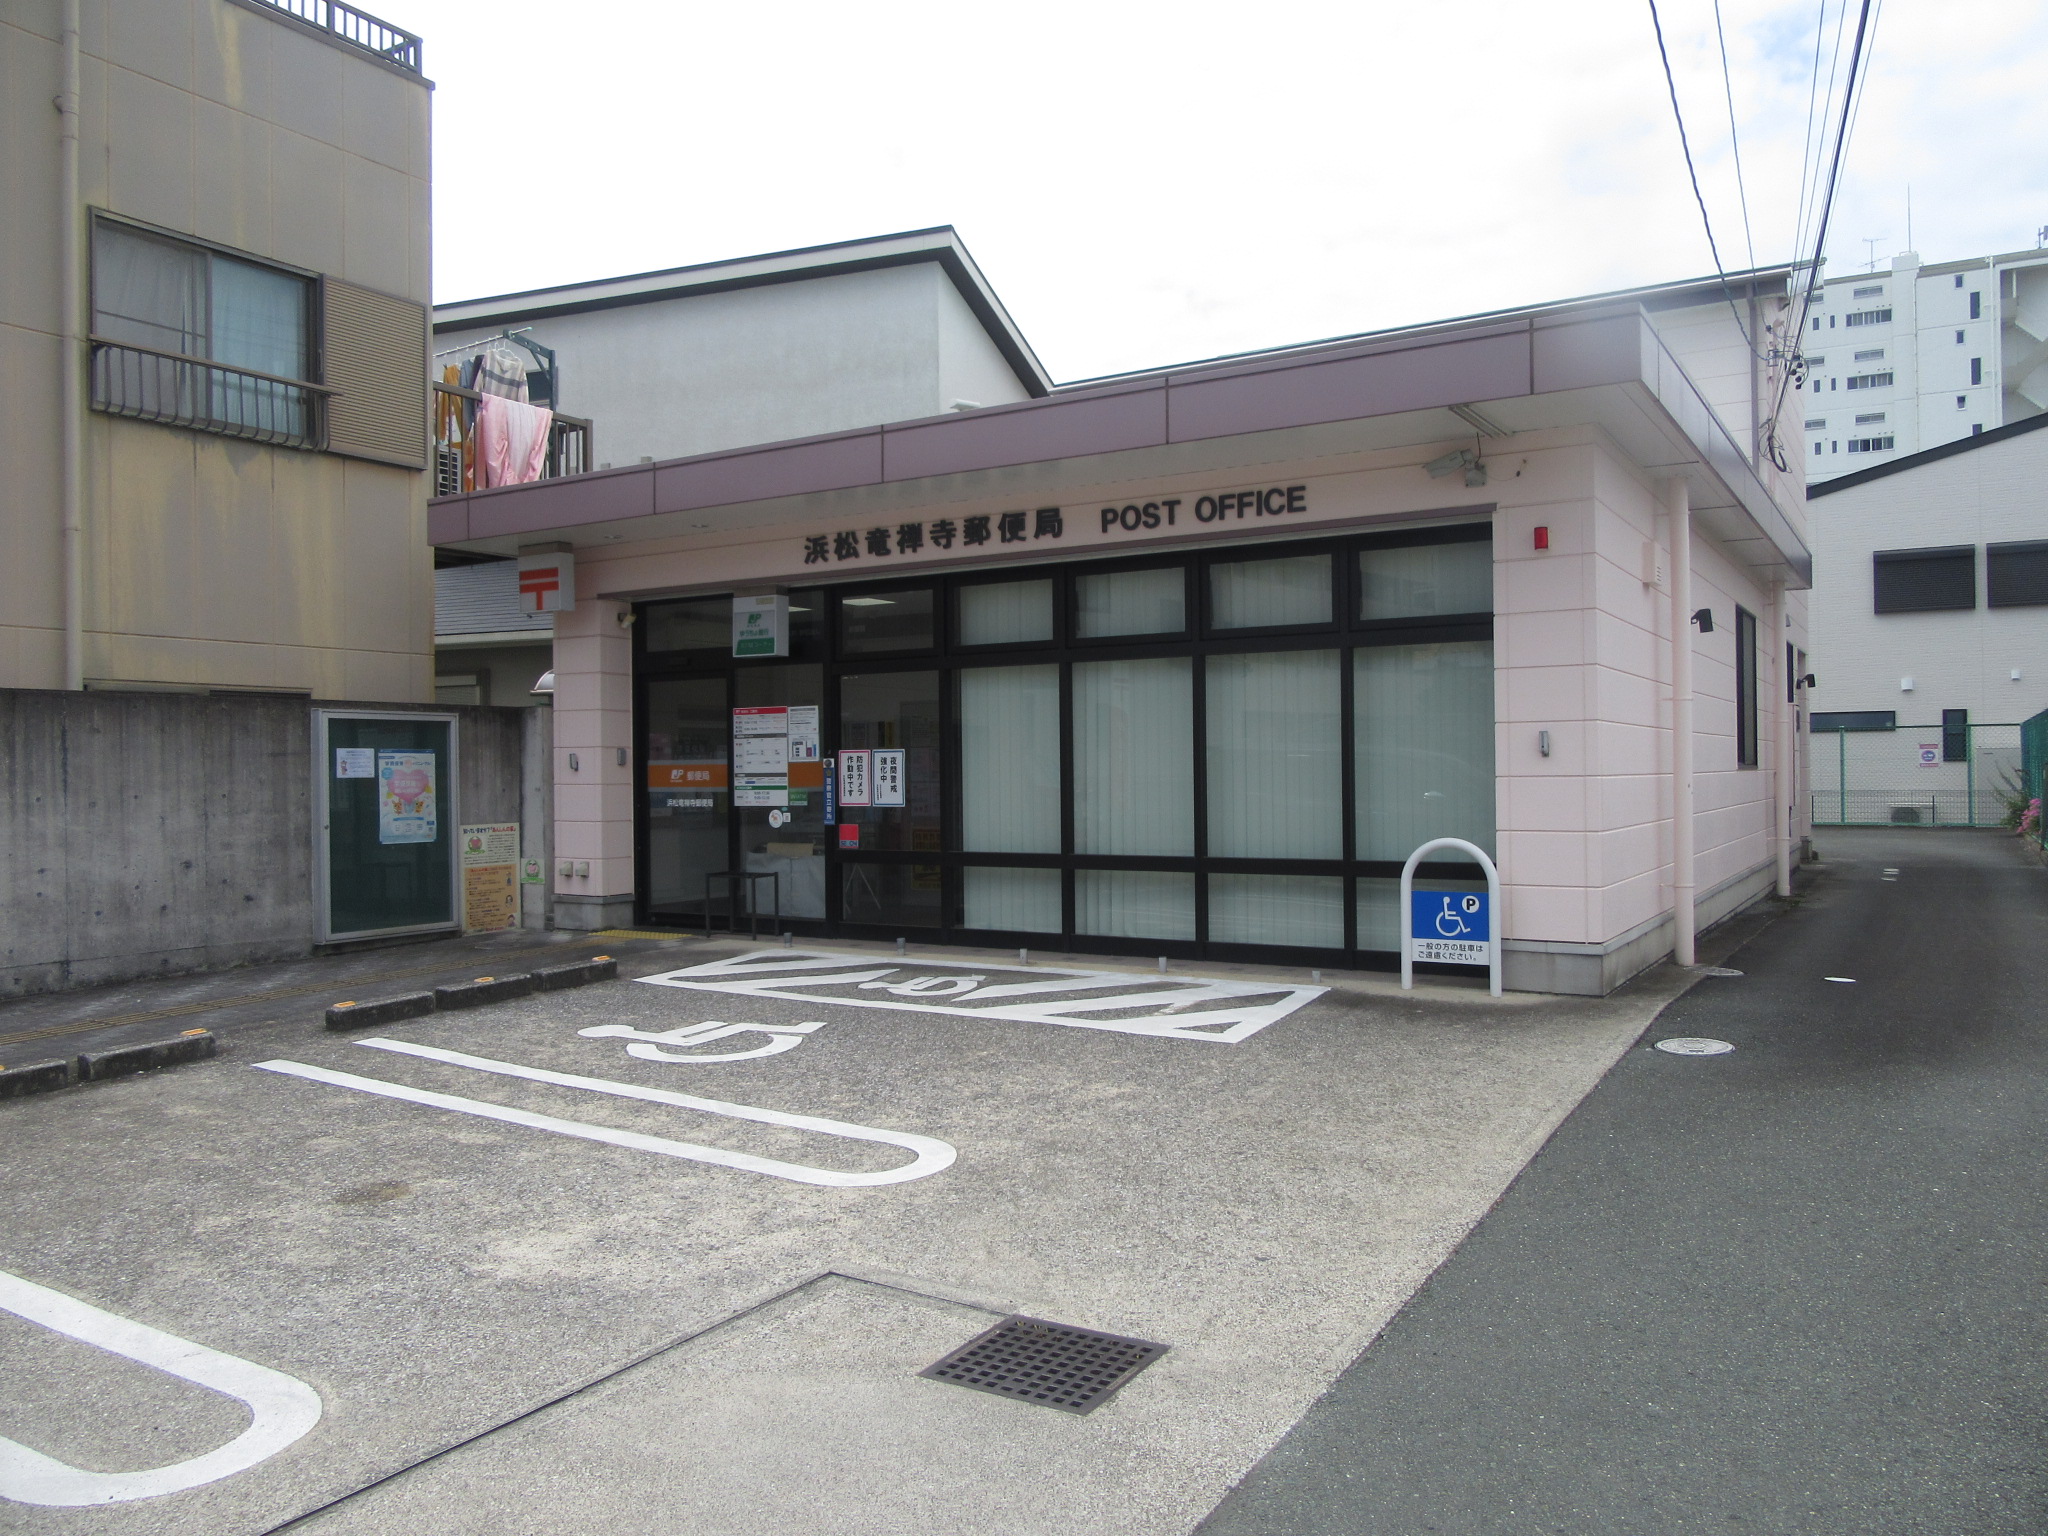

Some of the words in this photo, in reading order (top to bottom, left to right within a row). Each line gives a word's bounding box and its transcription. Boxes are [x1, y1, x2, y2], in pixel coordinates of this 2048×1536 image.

[1101, 499, 1181, 533] POST
[1194, 486, 1307, 522] OFFICE
[687, 770, 710, 781] 郵便局
[856, 755, 864, 796] 防犯カメラ
[880, 756, 888, 783] 強化中
[889, 756, 898, 793] 夜間警戒
[1466, 898, 1476, 911] P
[1417, 942, 1484, 953] 一般の方の駐車は
[1418, 950, 1477, 961] ご遠慮ください。
